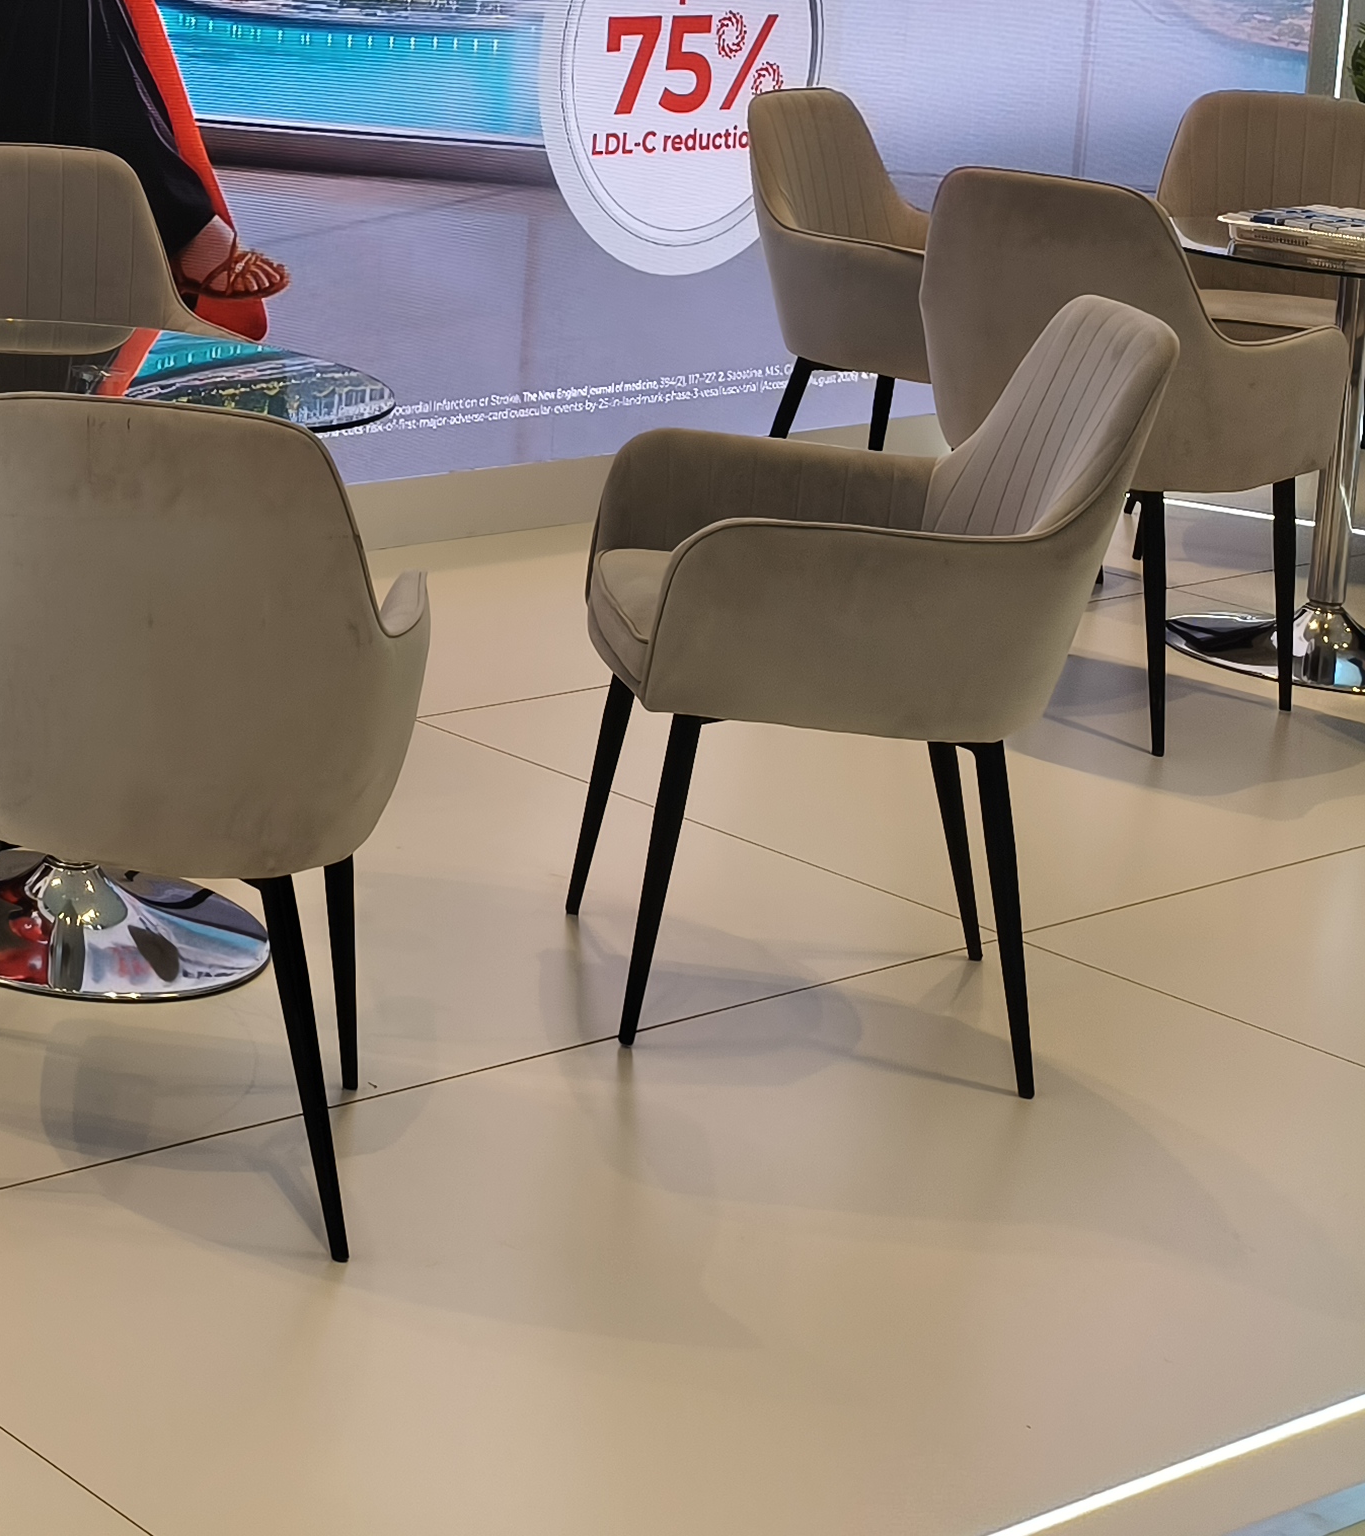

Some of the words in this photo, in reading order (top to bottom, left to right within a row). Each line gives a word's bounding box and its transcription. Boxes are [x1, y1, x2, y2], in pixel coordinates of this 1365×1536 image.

[606, 10, 784, 115] 75%
[591, 130, 658, 156] LDL-C
[662, 125, 750, 153] reductio
